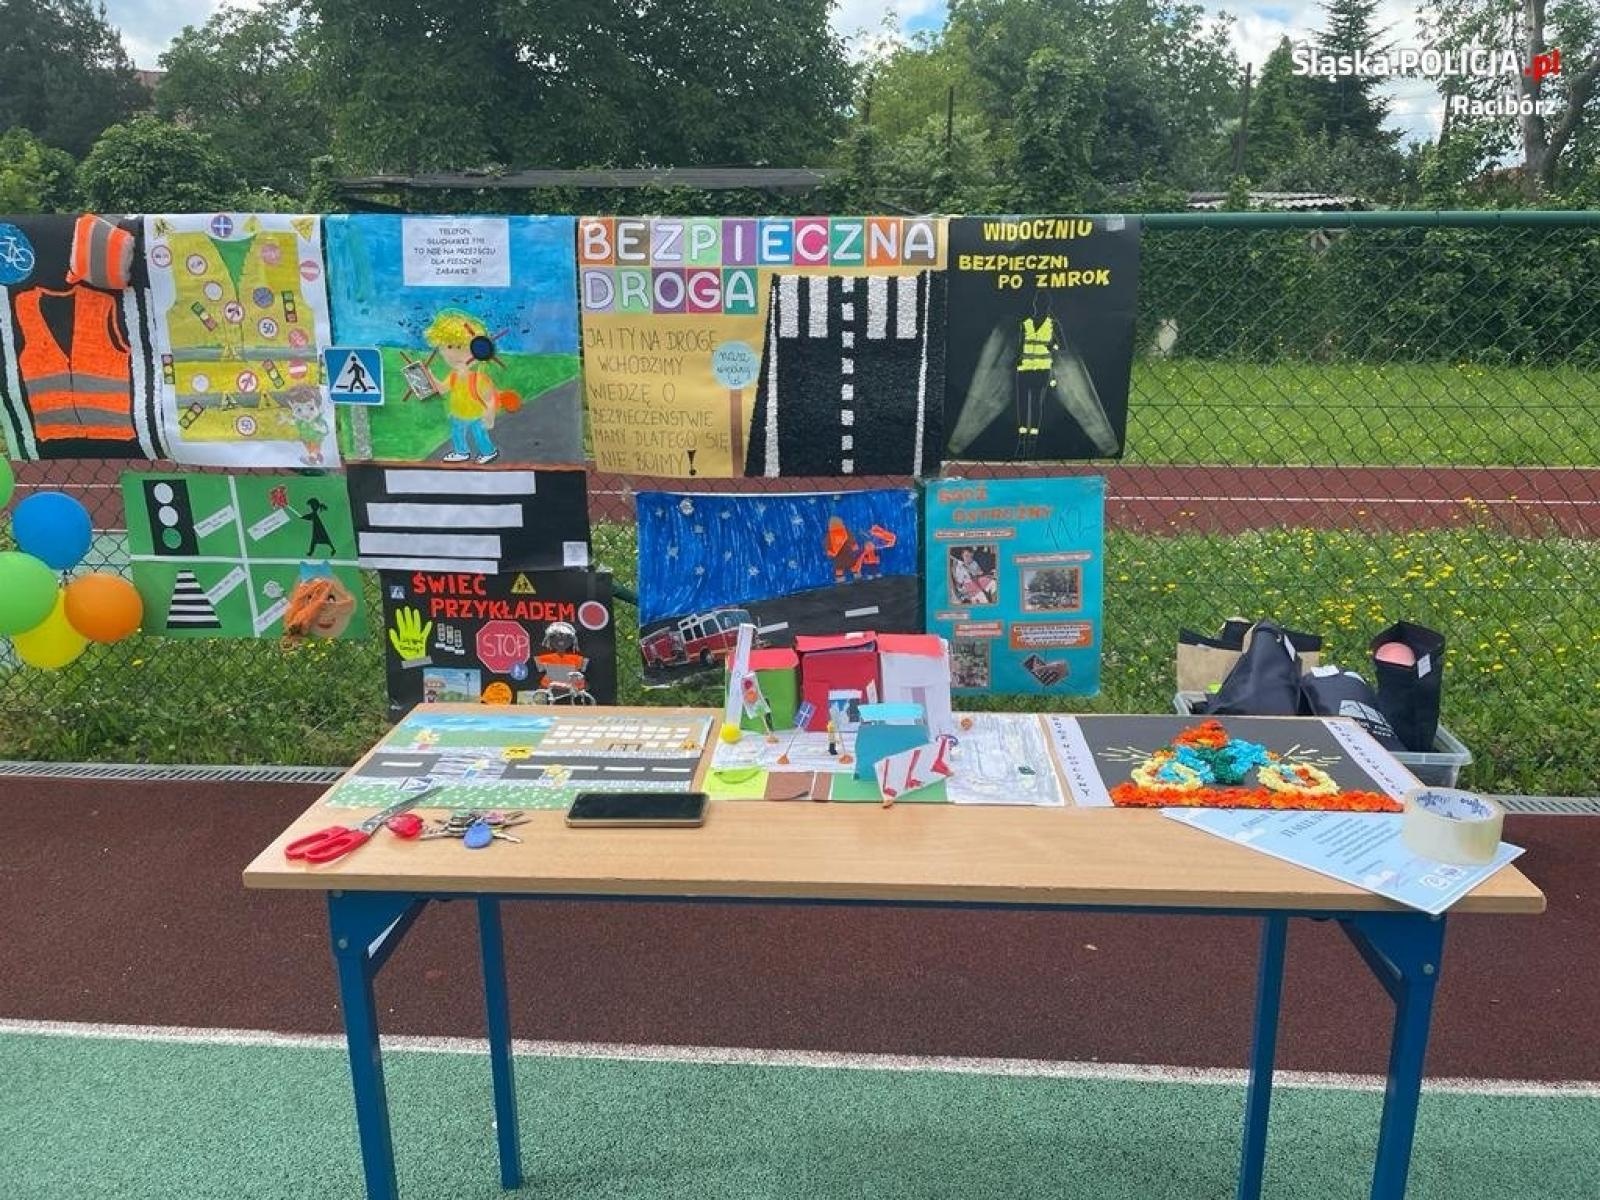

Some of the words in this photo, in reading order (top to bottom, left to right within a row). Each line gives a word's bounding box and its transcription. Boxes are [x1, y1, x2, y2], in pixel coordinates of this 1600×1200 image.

[414, 248, 425, 256] TO
[427, 247, 441, 256] NIE
[583, 222, 935, 263] BEZPIECZNA
[431, 257, 445, 265] DLA
[447, 257, 482, 265] PIESZYCH
[958, 254, 1070, 272] BEZPIECZNI
[583, 269, 757, 311] DROGA
[998, 274, 1024, 290] PO
[1035, 269, 1112, 289] ZMROK
[586, 327, 606, 349] JA
[616, 326, 636, 352] TY
[640, 328, 662, 351] NA
[598, 354, 684, 376] WCHODZIMY
[662, 382, 677, 404] O
[594, 428, 628, 446] MAMY
[635, 430, 698, 449] DLATEGO
[601, 451, 628, 467] NIE
[431, 598, 576, 622] PRZYKŁADEM
[482, 633, 528, 658] STOP
